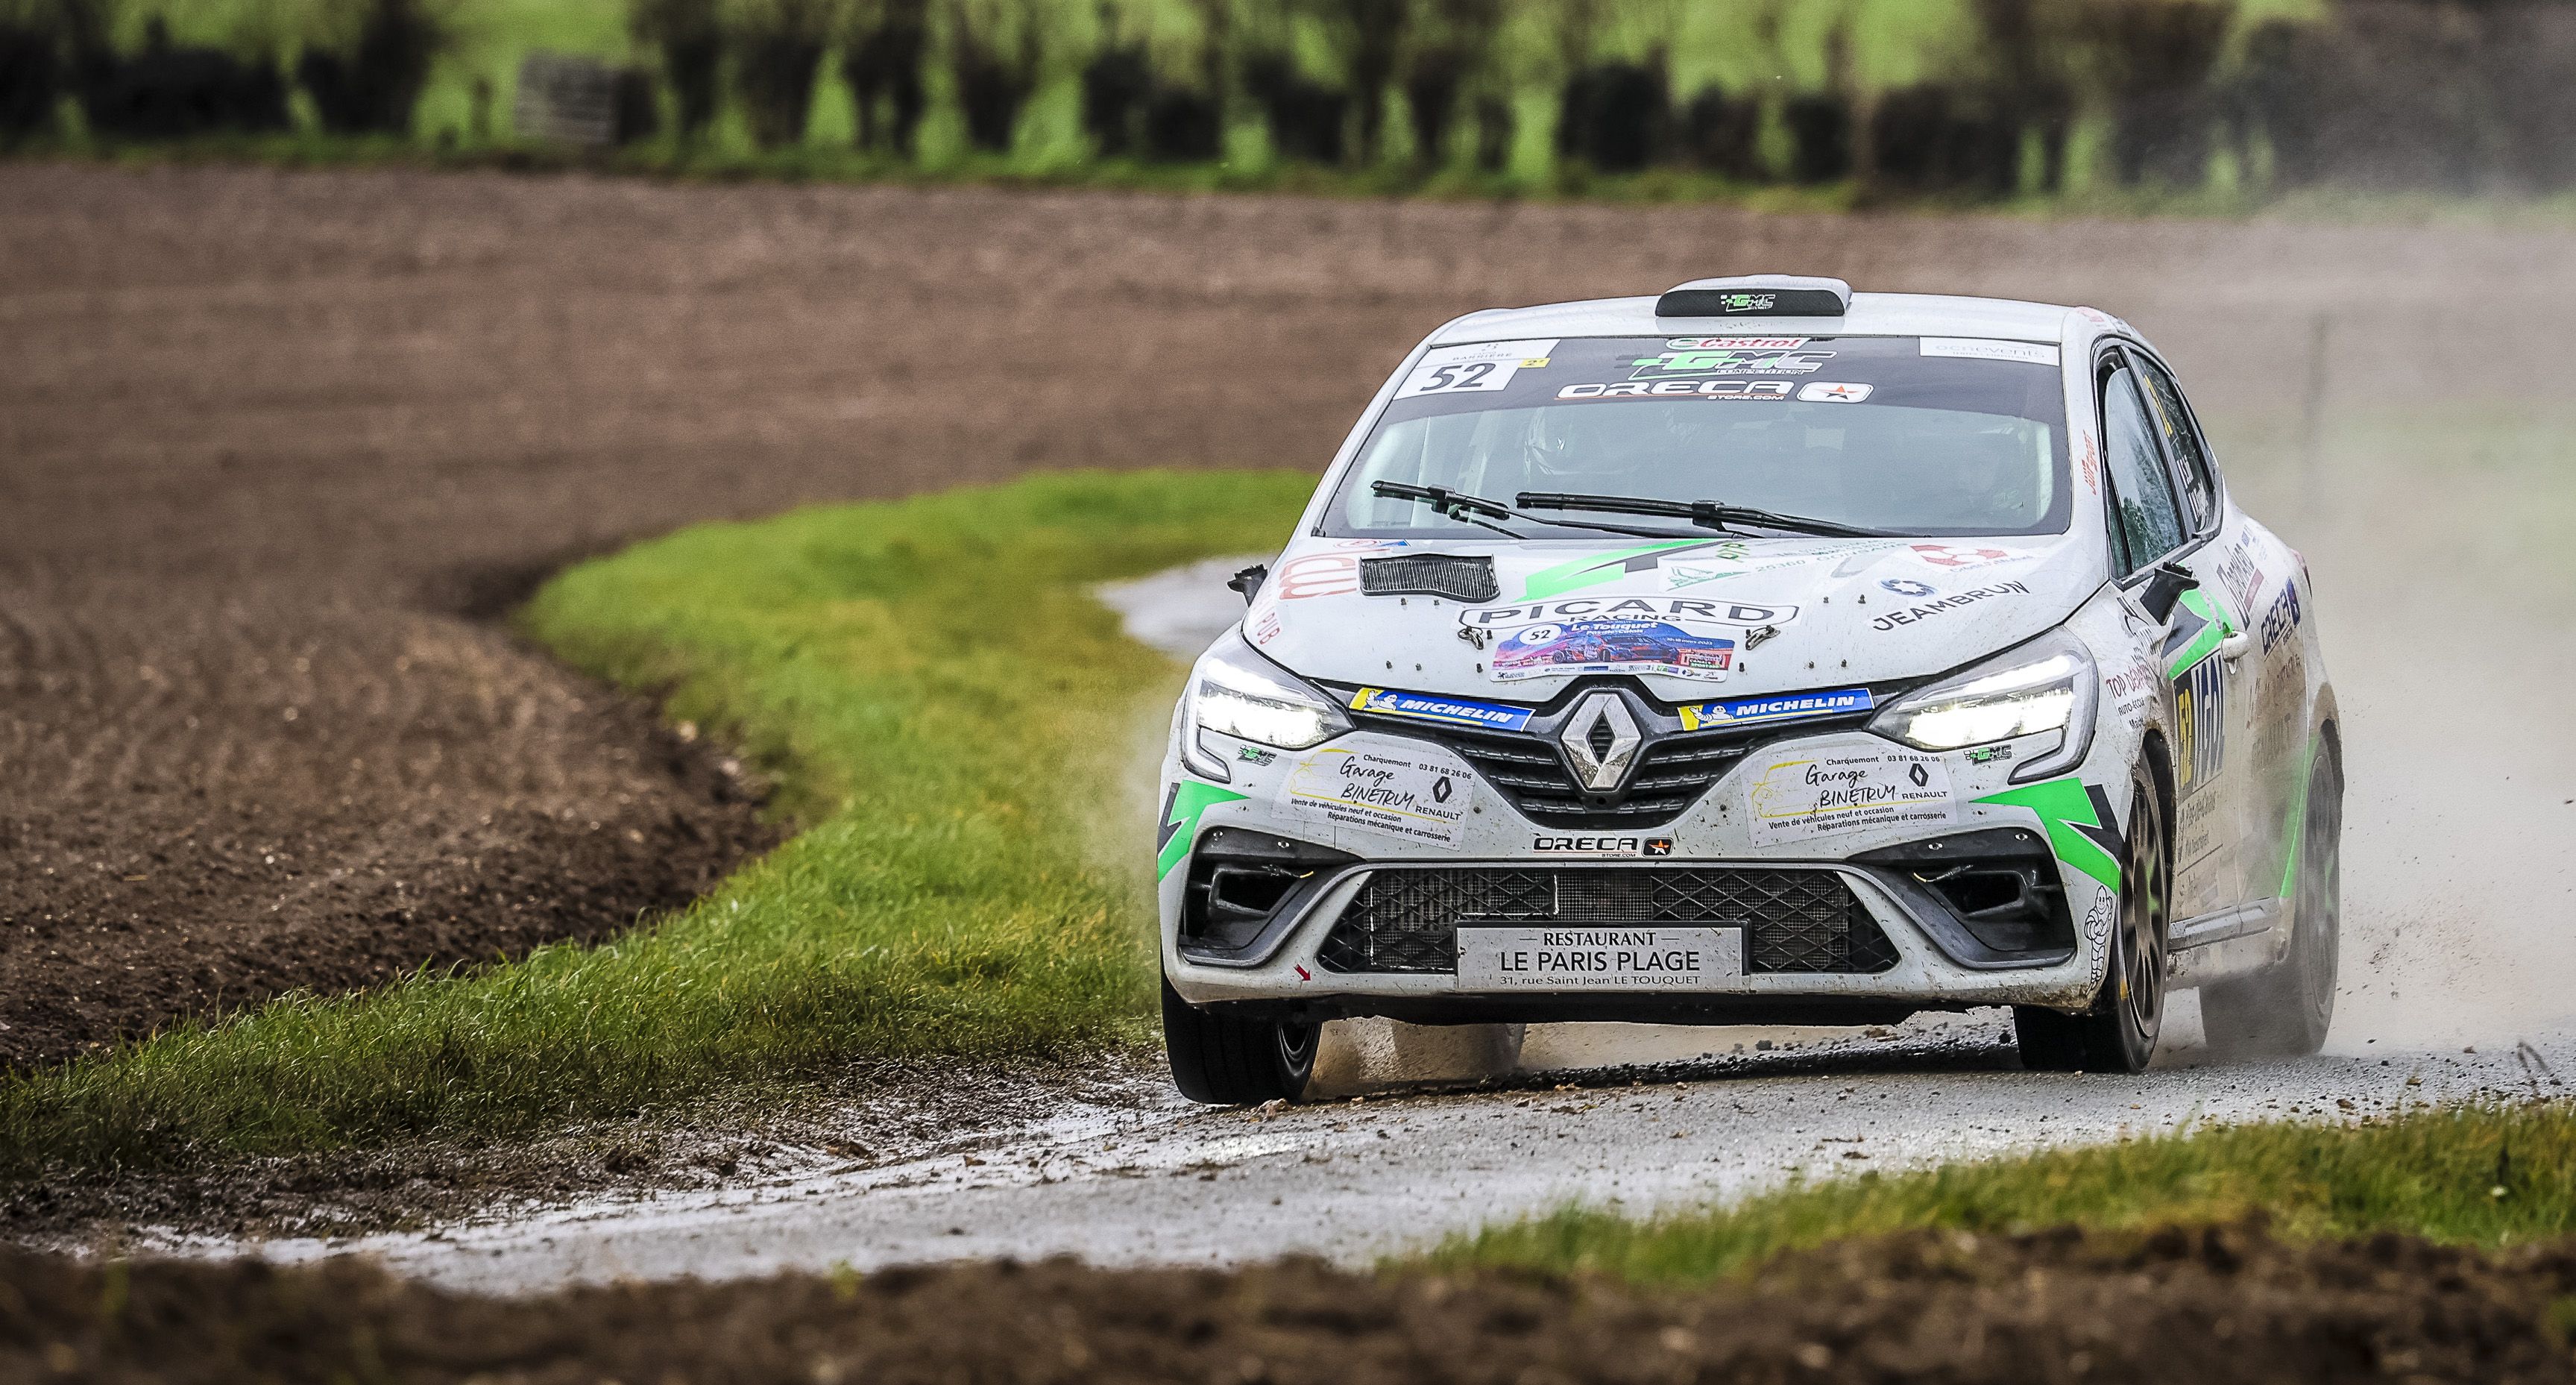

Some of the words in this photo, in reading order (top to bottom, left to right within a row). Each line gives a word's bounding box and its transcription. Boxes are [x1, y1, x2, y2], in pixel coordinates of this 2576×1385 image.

[1699, 338, 1803, 348] Castrol
[1420, 362, 1497, 392] 52
[1557, 380, 1795, 398] ORECA
[1478, 598, 1775, 624] PICARD
[1872, 580, 2031, 632] JEAMBRUN
[1569, 614, 1682, 624] RACING
[1593, 621, 1659, 630] Touquet
[1529, 629, 1552, 641] 52
[2106, 674, 2127, 699] TOP
[1399, 698, 1515, 724] MICHELIN
[1735, 694, 1857, 717] MICHELIN
[2178, 688, 2192, 788] 52
[1363, 754, 1411, 768] Charquemont
[1826, 756, 1880, 766] Charquemont
[1340, 756, 1395, 788] Garage
[1451, 769, 1461, 777] 26
[1805, 764, 1868, 788] Garage
[1341, 782, 1416, 811] BINETRUY
[1820, 785, 1896, 808] BINETRUY
[1901, 791, 1947, 800] RENAULT
[1291, 797, 1309, 806] Vente
[1318, 802, 1347, 813] véhicules
[1348, 807, 1364, 816] neuf
[1373, 812, 1402, 823] occasion
[1415, 805, 1461, 821] RENAULT
[1768, 820, 1790, 829] Vente
[1791, 817, 1801, 826] de
[1801, 813, 1835, 824] véhicules
[1836, 810, 1853, 819] neuf
[1863, 807, 1895, 815] occasion
[1327, 811, 1366, 826] Réparations
[1367, 820, 1404, 833] mécanique
[1405, 827, 1413, 835] et
[1413, 829, 1451, 842] carrosserie
[1817, 819, 1860, 832] Réparations
[1861, 814, 1900, 825] mécanique
[1910, 811, 1947, 820] carrosserie
[1533, 838, 1638, 851] ORECA
[1543, 931, 1657, 947] RESTAURANT
[1500, 952, 1528, 971] LE
[1537, 952, 1607, 971] PARIS
[1617, 952, 1701, 971] PLAGE
[1499, 976, 1519, 986] 31,
[1522, 977, 1543, 985] rue
[1546, 976, 1580, 985] Saint
[1582, 976, 1610, 985] Jean
[1614, 976, 1628, 985] LE
[1631, 976, 1701, 986] TOUQUET
